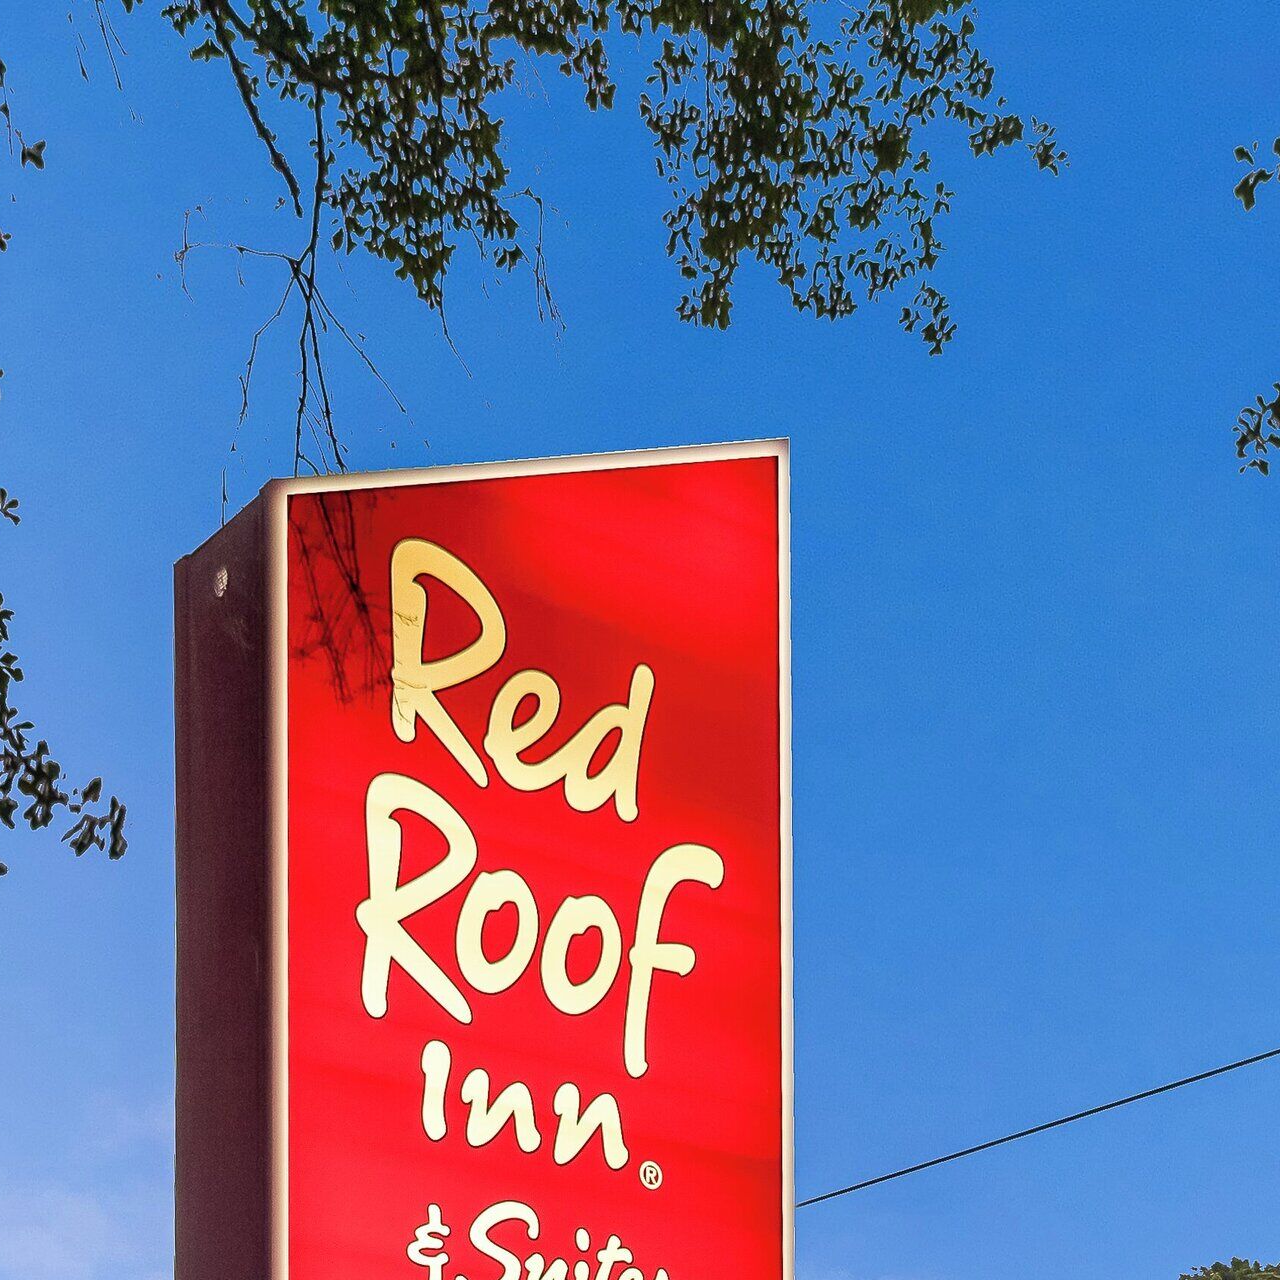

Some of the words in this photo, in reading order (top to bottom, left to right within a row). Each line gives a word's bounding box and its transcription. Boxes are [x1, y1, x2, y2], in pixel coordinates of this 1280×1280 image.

[390, 538, 656, 823] Red
[354, 772, 725, 1079] Roof
[420, 1039, 631, 1171] Inn
